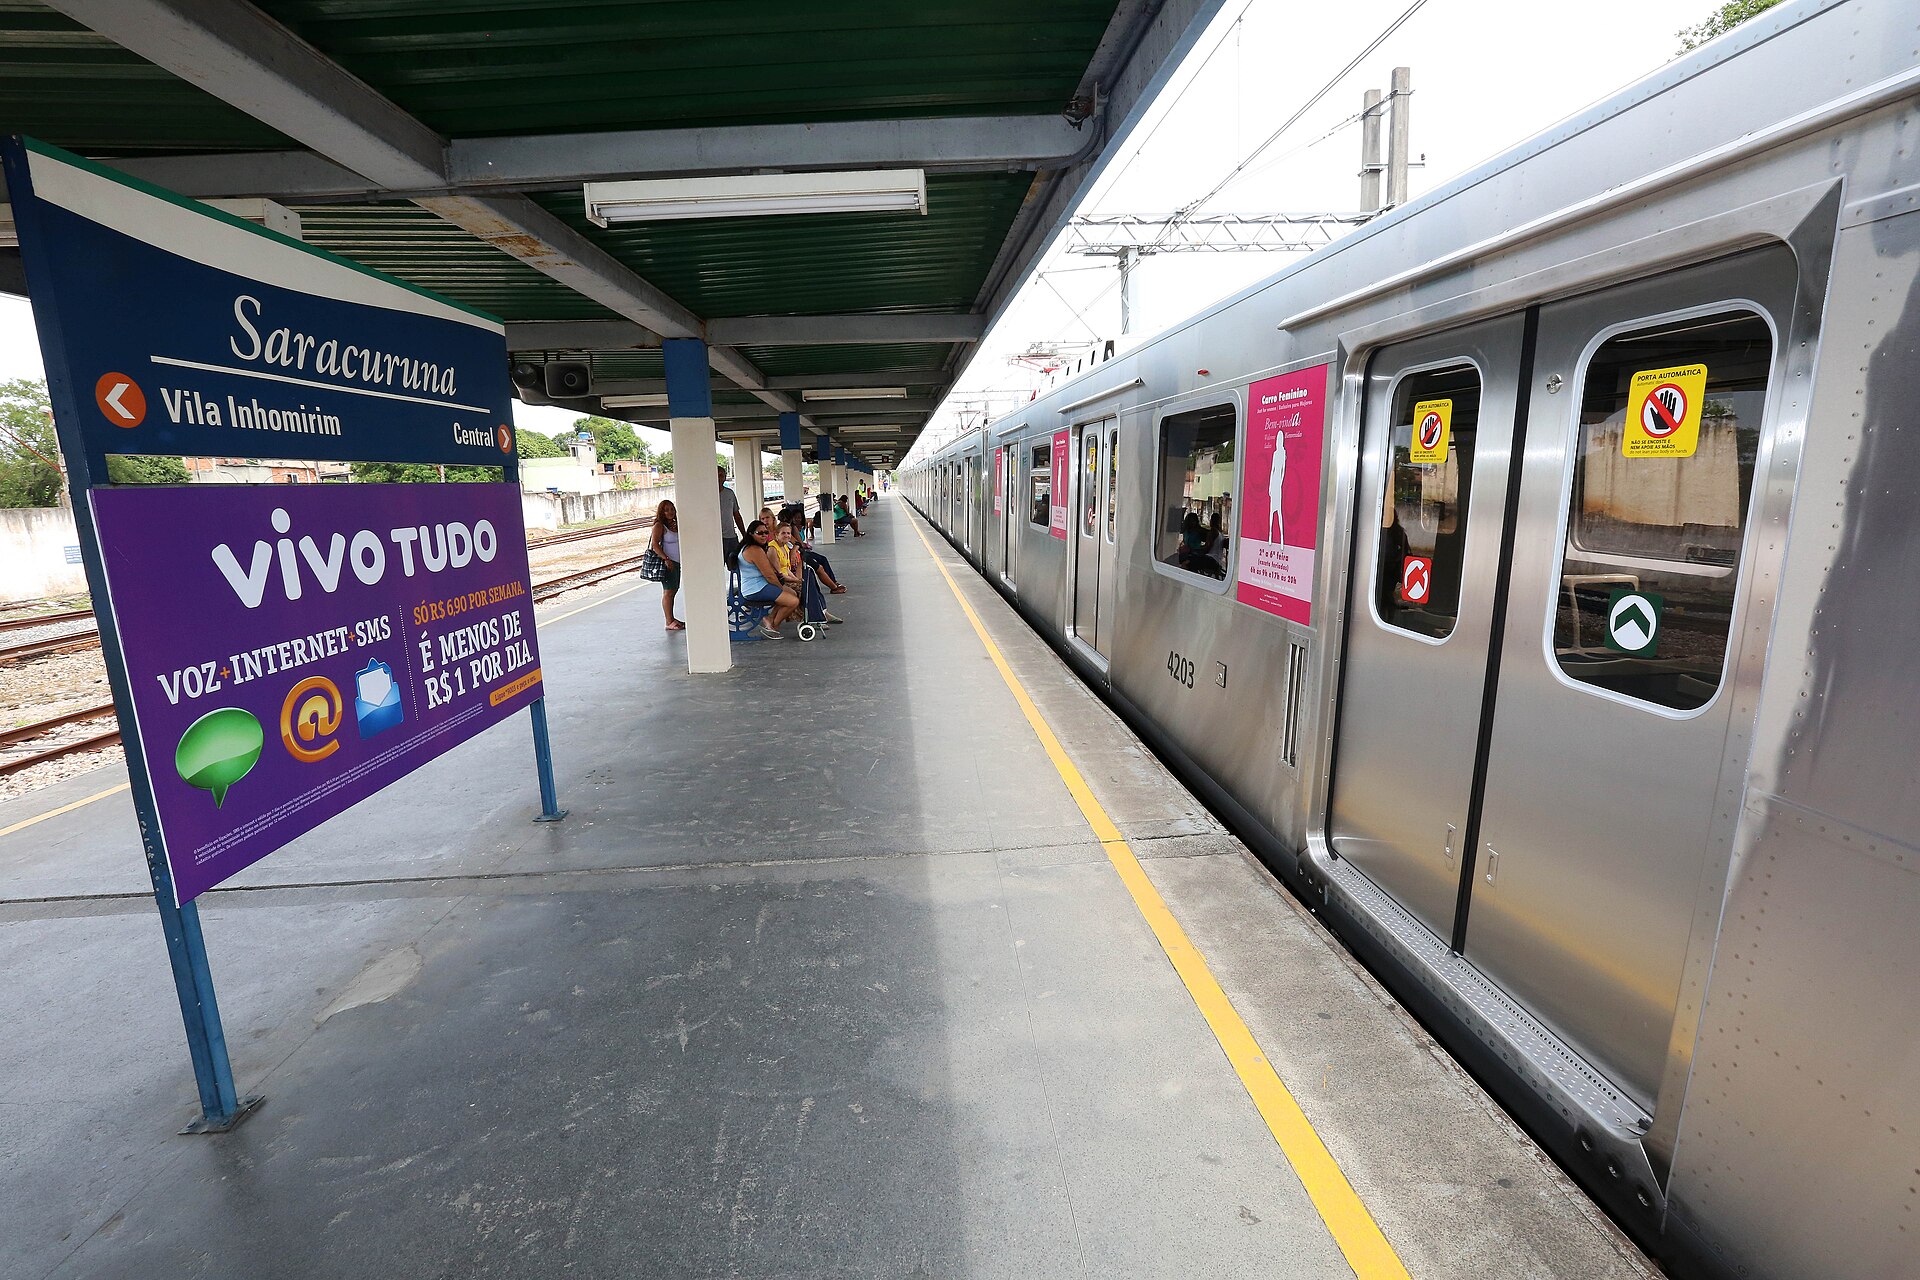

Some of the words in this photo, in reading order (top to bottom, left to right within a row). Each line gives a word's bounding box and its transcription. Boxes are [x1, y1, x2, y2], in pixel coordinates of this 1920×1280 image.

[229, 294, 457, 397] Saracuruna
[1261, 394, 1278, 405] Carro
[1278, 387, 1308, 402] Feminino
[1637, 374, 1657, 382] PORTA
[1658, 368, 1702, 379] AUTOMÁTICA
[160, 387, 221, 426] Vila
[228, 395, 342, 436] Inhomirim
[453, 421, 495, 449] Central
[390, 519, 498, 578] TUDO
[1276, 551, 1289, 562] feira
[1287, 575, 1297, 585] 20h
[413, 600, 429, 625] SÓ
[446, 595, 467, 616] 6,90
[468, 590, 489, 610] POR
[488, 580, 525, 604] SEMANA.
[418, 630, 435, 673] É
[438, 617, 500, 666] MENOS
[502, 610, 522, 641] DE
[469, 651, 504, 689] POR
[505, 639, 534, 672] DIA.
[1167, 650, 1195, 689] 4203
